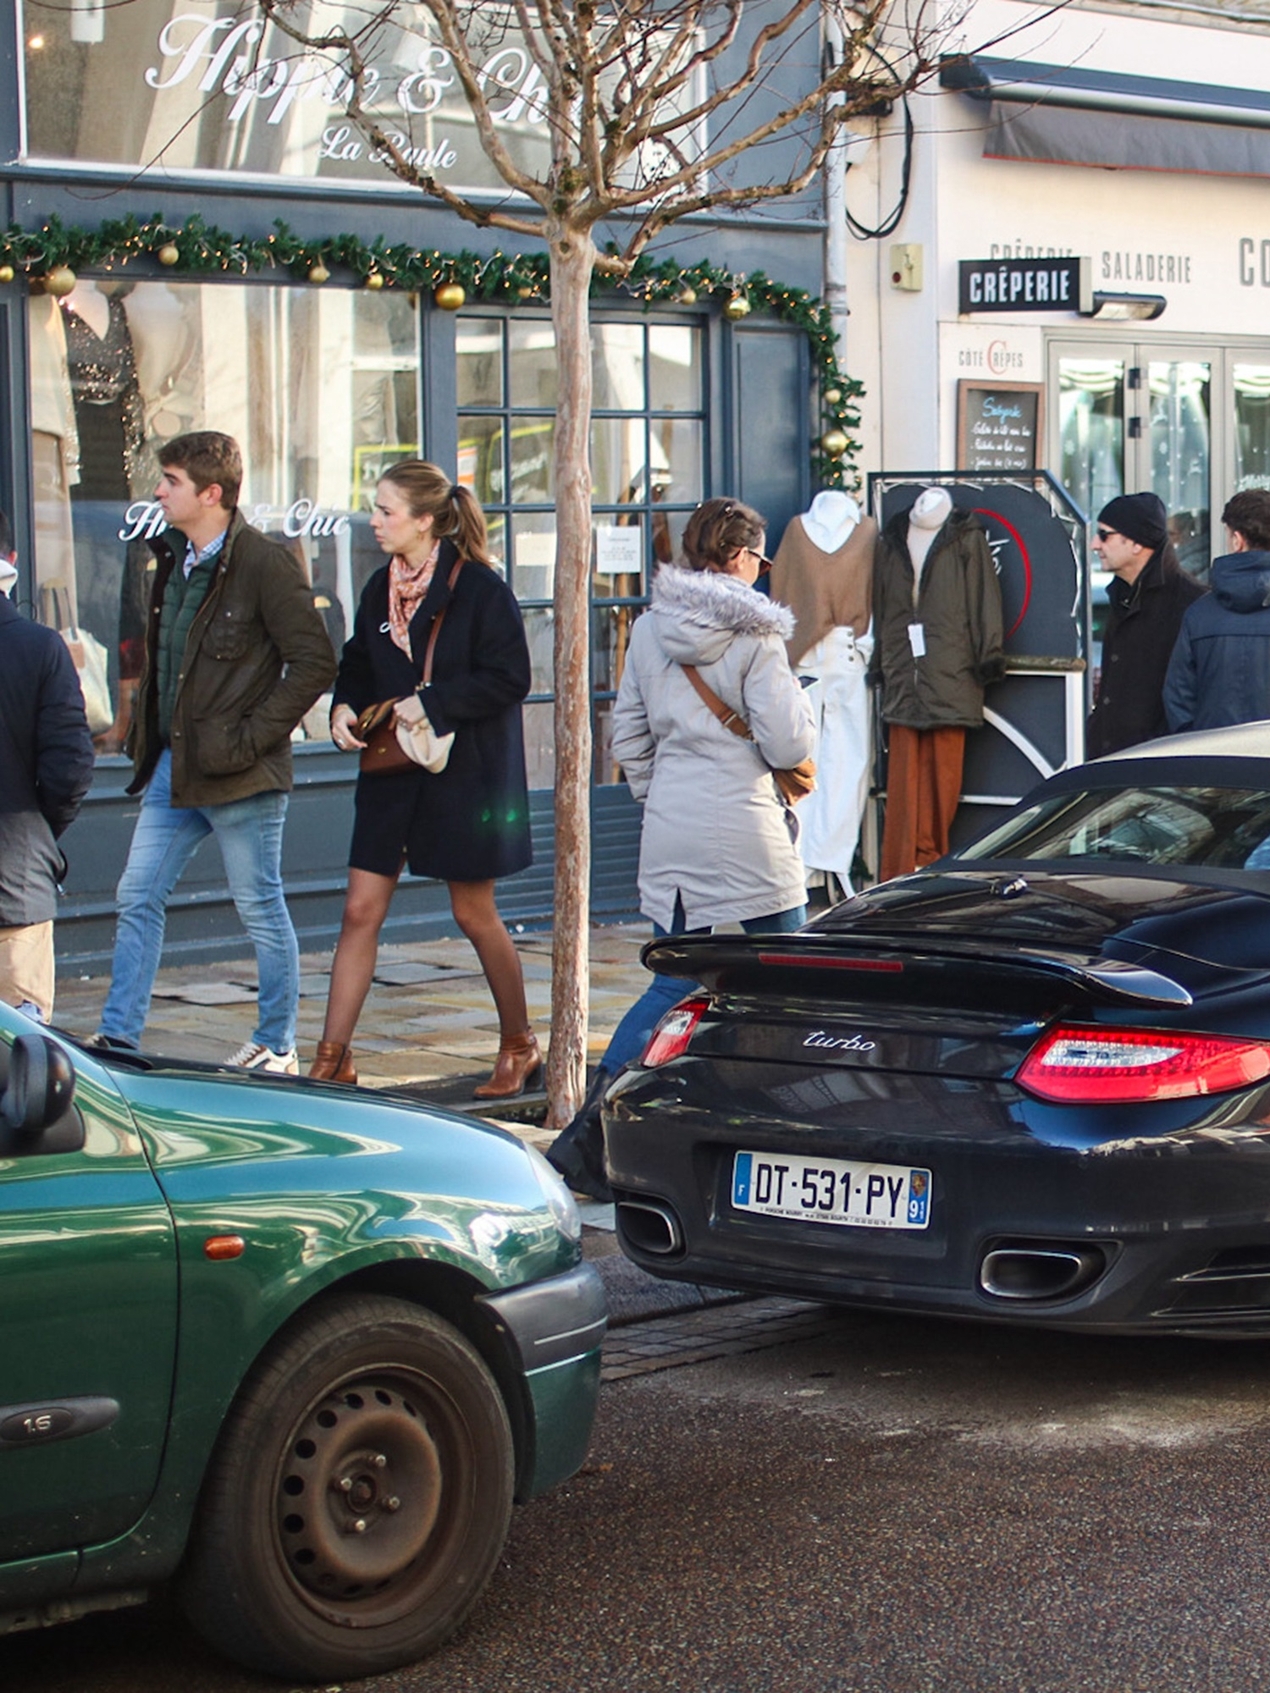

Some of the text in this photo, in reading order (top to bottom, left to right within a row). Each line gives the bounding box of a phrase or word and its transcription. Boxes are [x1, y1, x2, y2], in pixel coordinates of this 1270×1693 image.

[397, 48, 454, 113] &
[317, 126, 363, 161] La
[969, 266, 1070, 304] CRÊPERIE
[1102, 251, 1191, 283] SALADERIE
[281, 498, 350, 539] Chic
[802, 1030, 876, 1051] turbo
[737, 1184, 745, 1197] F
[755, 1163, 904, 1218] DT-531-PY
[23, 1415, 52, 1434] 1.6
